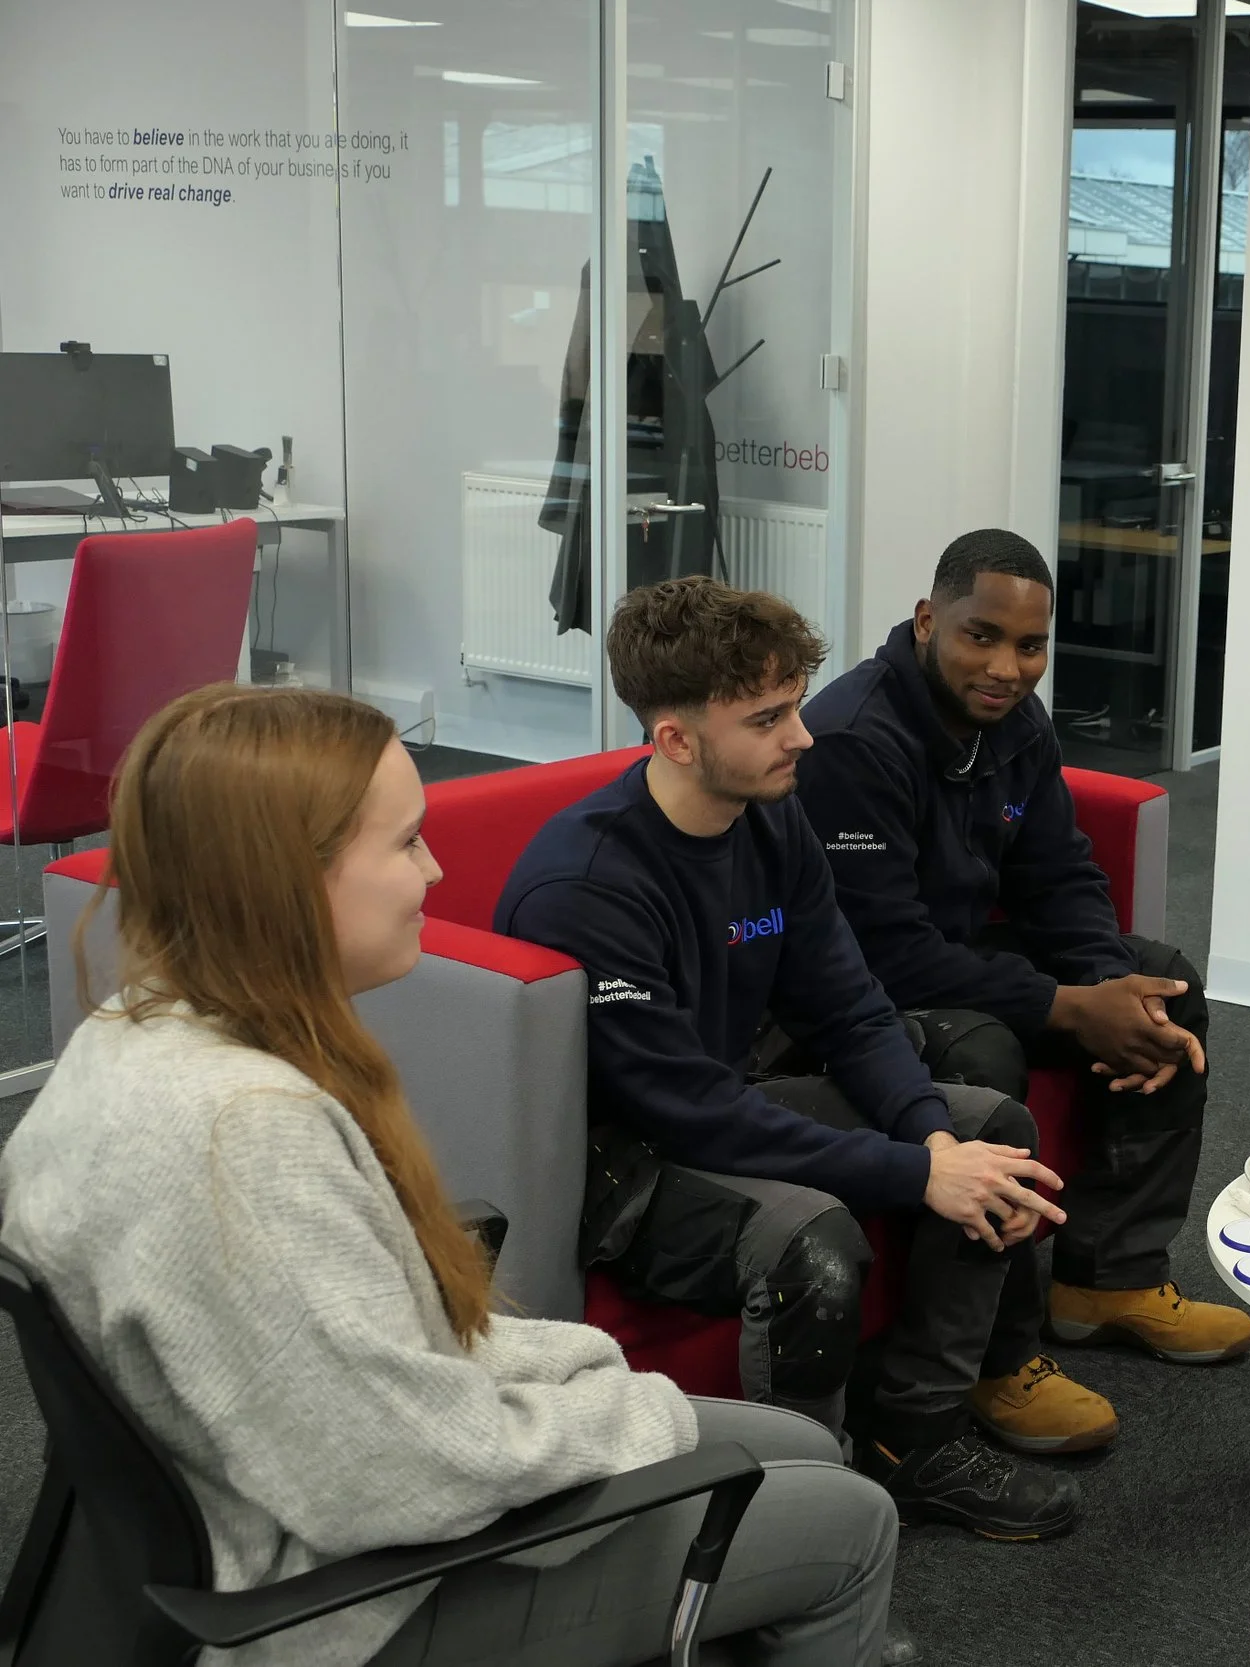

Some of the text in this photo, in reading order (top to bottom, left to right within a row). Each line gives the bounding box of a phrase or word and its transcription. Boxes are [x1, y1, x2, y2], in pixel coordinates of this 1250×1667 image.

[58, 127, 81, 145] You
[84, 127, 114, 146] have
[116, 128, 130, 146] to
[133, 128, 184, 146] believe
[188, 128, 200, 146] in
[204, 129, 224, 147] the
[228, 129, 261, 147] work
[265, 129, 291, 148] that
[295, 134, 320, 152] you
[351, 130, 395, 154] doing,
[400, 130, 409, 150] it
[59, 154, 391, 184] has to form part of the DNA of your busines if you
[60, 182, 236, 207] want to drive real change.
[826, 842, 887, 851] bebetterbebell
[838, 831, 874, 840] #believe
[742, 907, 785, 942] bell
